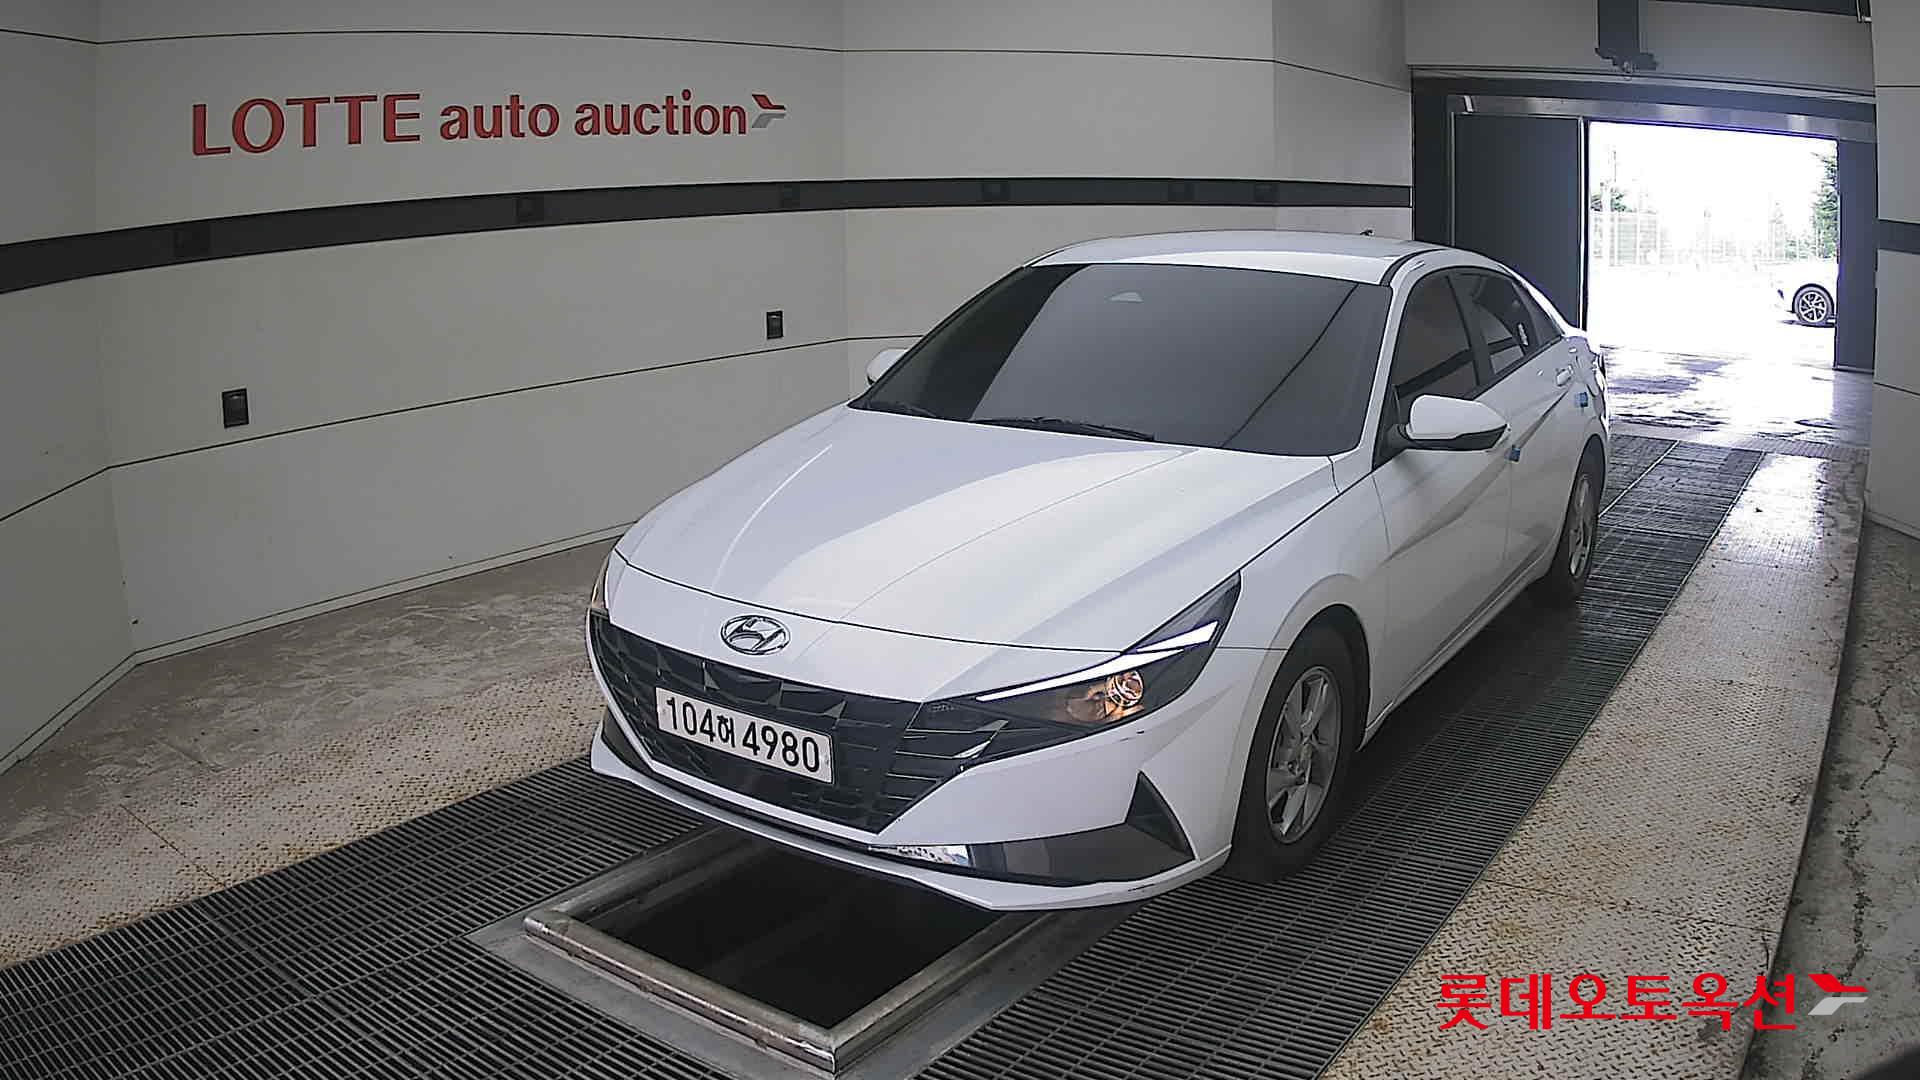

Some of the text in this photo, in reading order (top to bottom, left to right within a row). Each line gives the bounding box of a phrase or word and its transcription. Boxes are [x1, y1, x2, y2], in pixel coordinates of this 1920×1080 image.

[192, 89, 748, 156] LOTTE auto auction
[666, 697, 820, 773] 104허 4980
